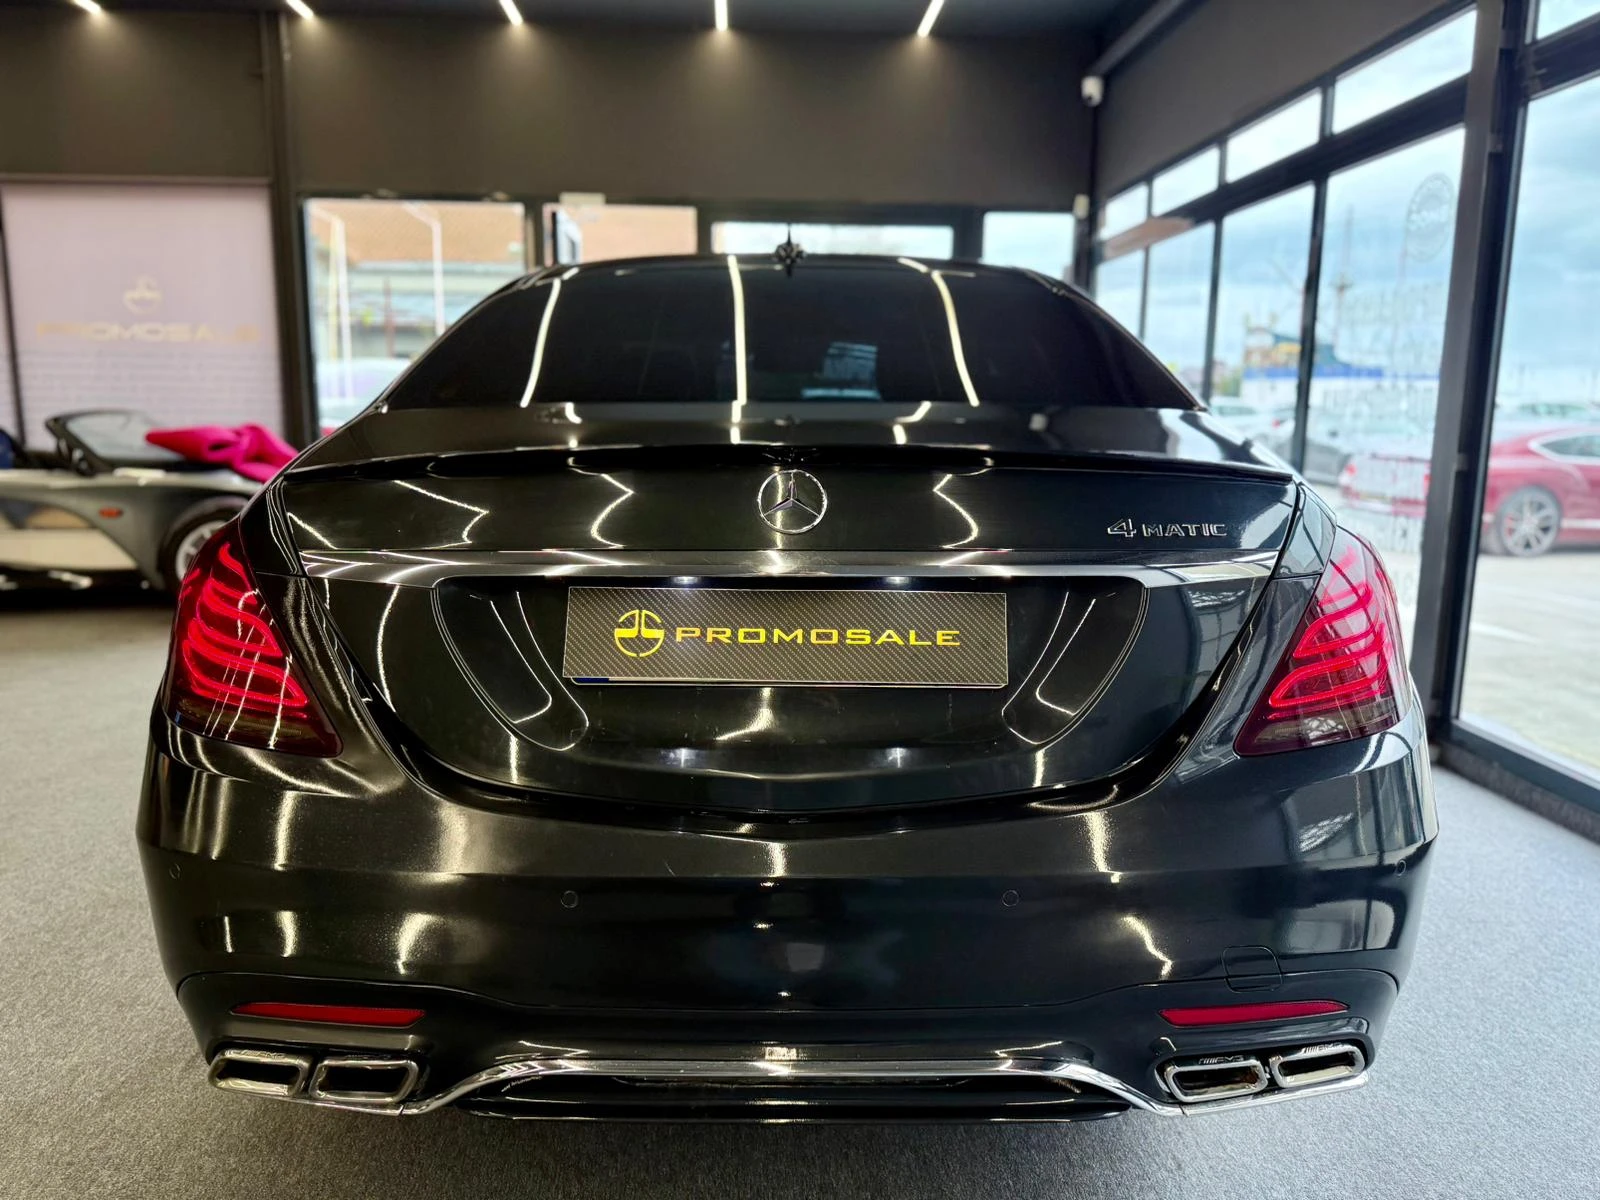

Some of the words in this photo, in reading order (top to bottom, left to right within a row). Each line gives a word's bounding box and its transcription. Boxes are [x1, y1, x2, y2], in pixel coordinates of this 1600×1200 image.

[1107, 518, 1137, 538] 4
[1142, 523, 1228, 538] MATIC
[676, 627, 961, 646] PROMOSALE
